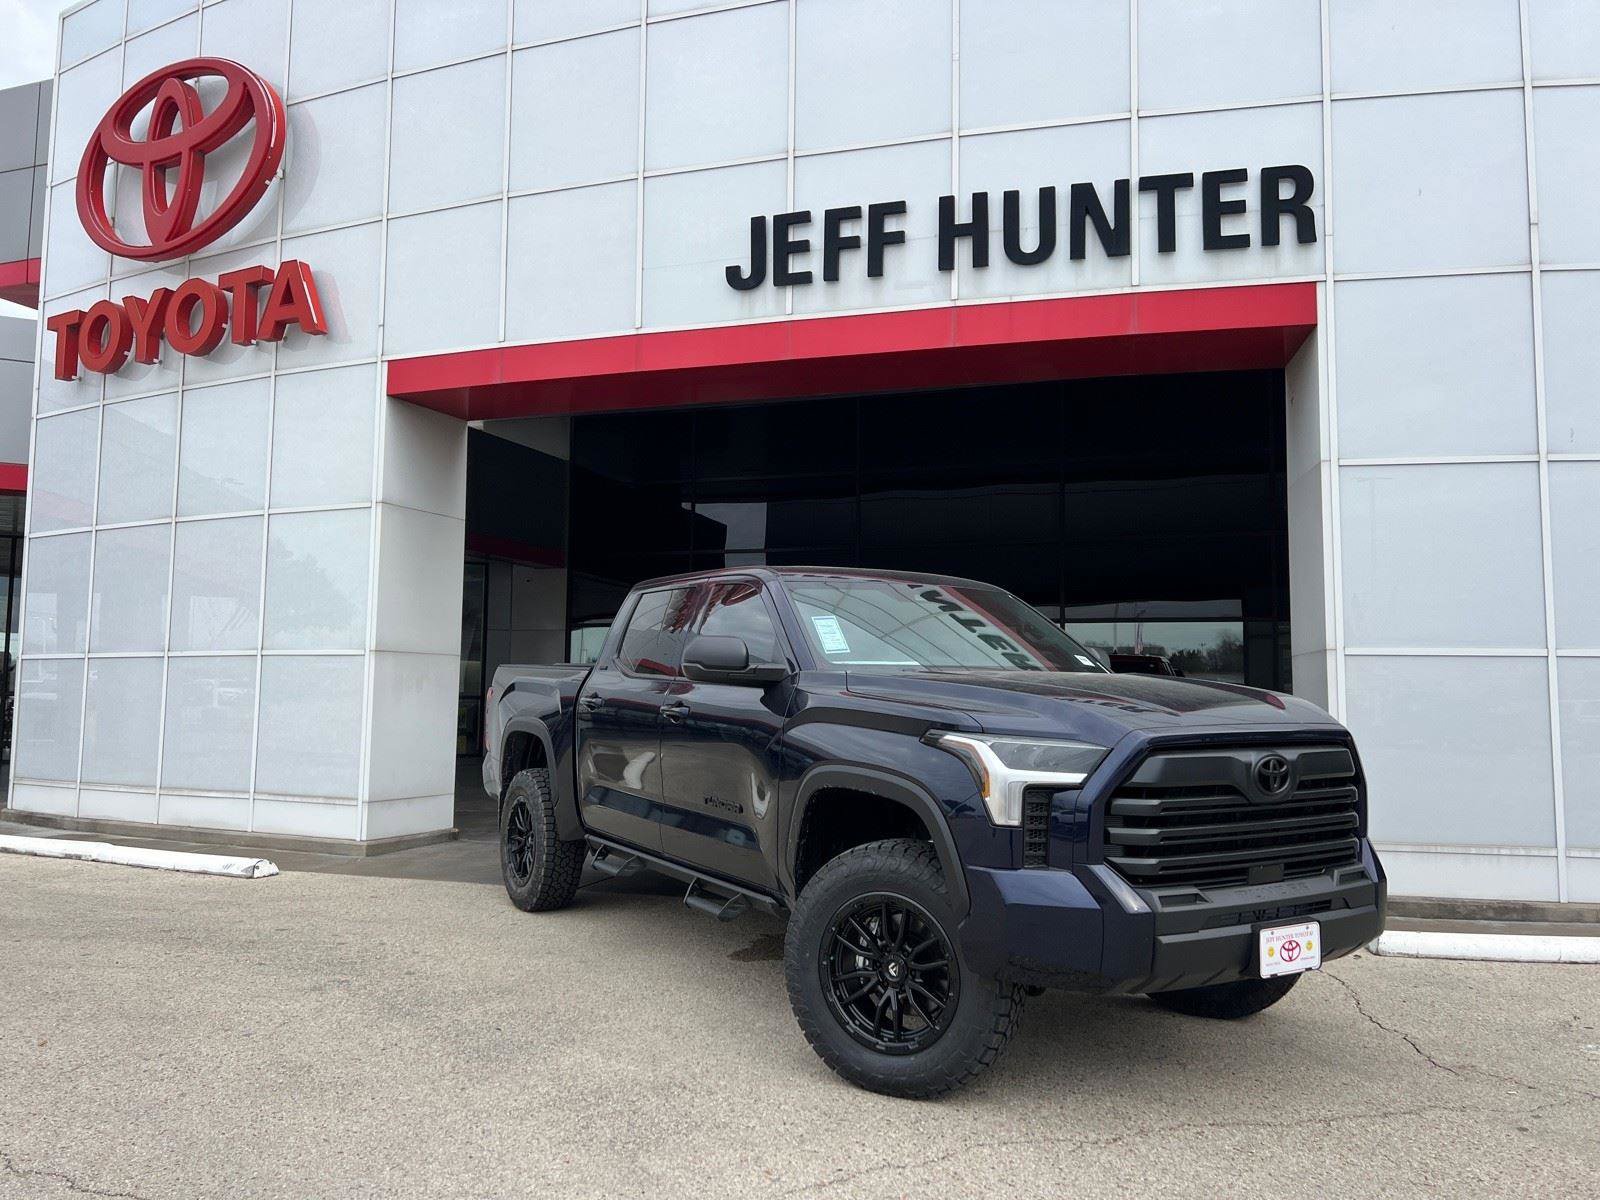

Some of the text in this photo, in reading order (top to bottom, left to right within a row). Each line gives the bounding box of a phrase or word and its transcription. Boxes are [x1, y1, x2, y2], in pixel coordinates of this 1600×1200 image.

[725, 164, 1318, 291] JEFF HUNTER
[47, 259, 328, 381] TOYOTA
